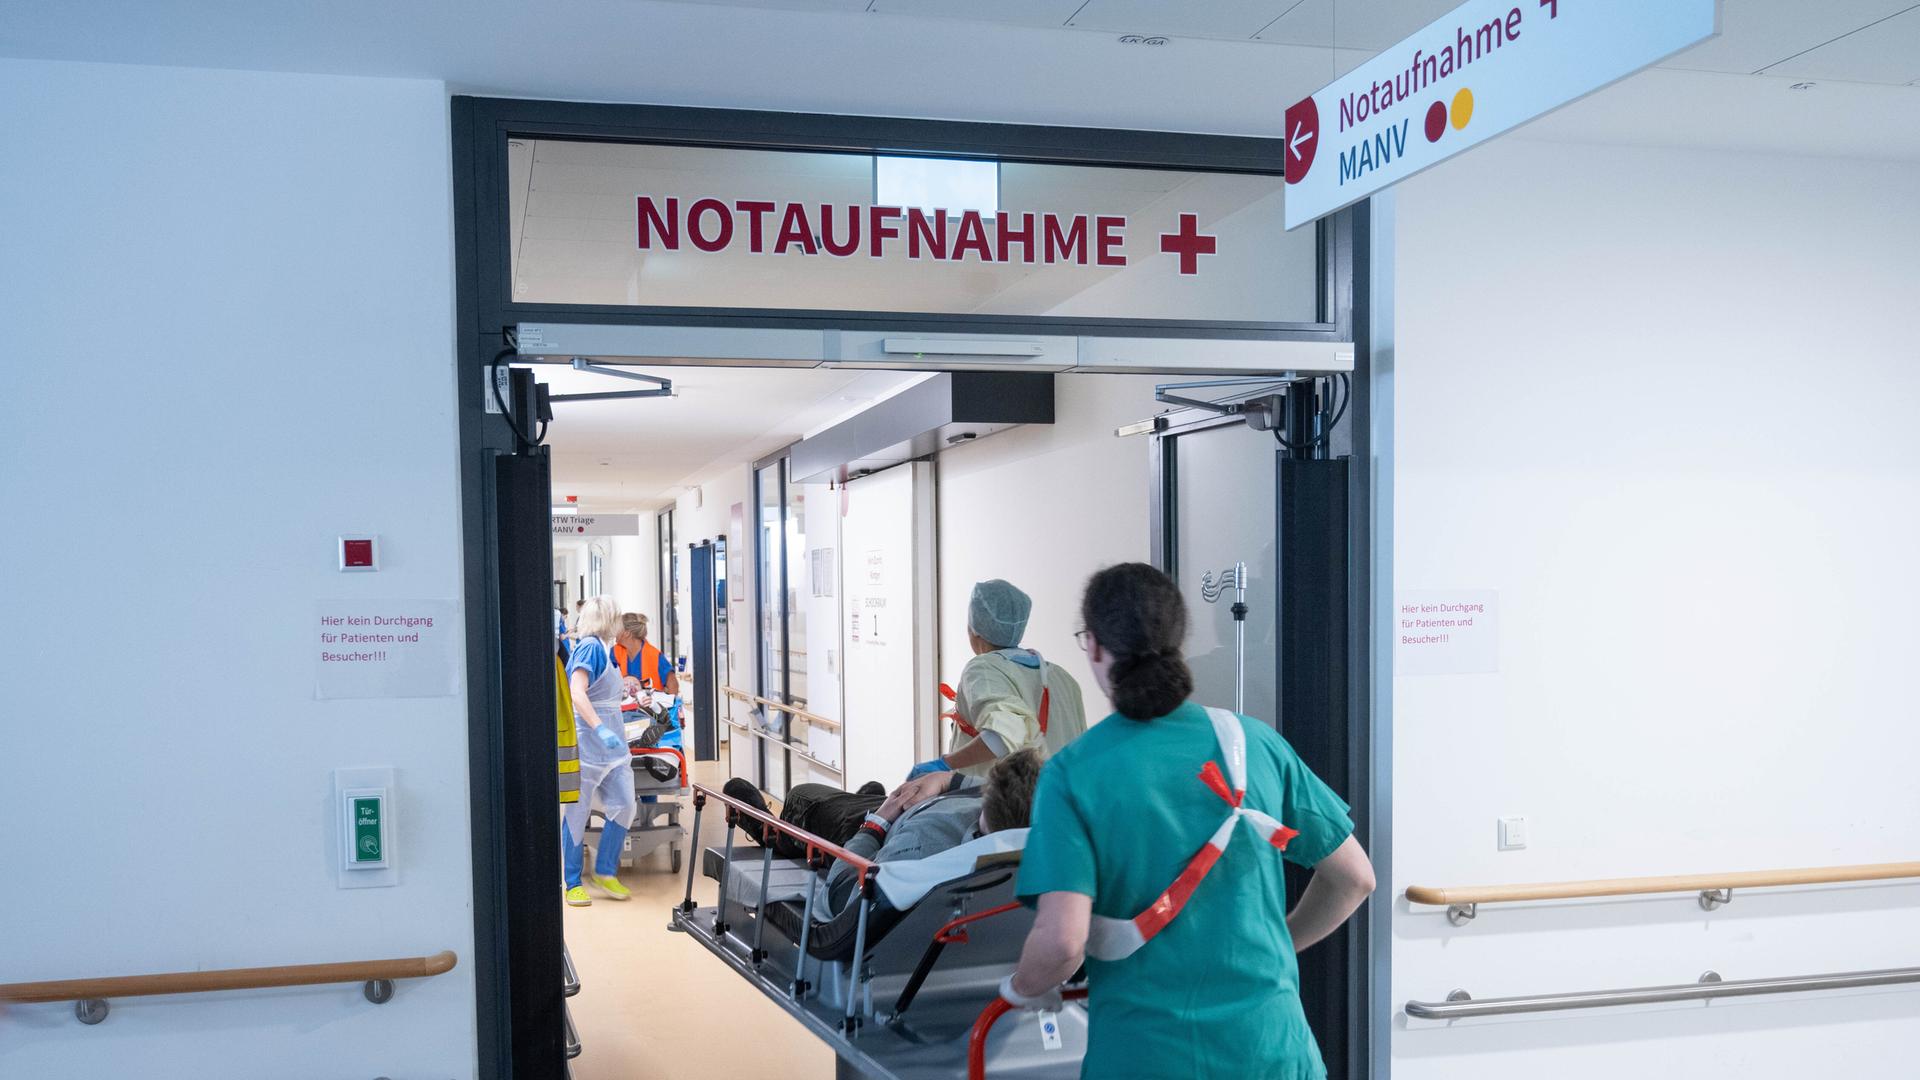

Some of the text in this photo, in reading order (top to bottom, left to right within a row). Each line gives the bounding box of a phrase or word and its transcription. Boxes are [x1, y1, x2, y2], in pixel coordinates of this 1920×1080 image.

[1340, 7, 1522, 133] Notaufnahme
[1340, 118, 1409, 186] MANV
[636, 196, 1127, 266] NOTAUFNAHME
[570, 516, 595, 525] Triage
[1402, 603, 1484, 613] Hier kein Durchgang
[321, 615, 433, 627] Hier kein Durchgang
[1402, 617, 1473, 628] für Patienten und
[321, 632, 419, 643] für Patienten und
[1402, 634, 1449, 644] Besucher!!!
[322, 651, 386, 662] Besucher!!!
